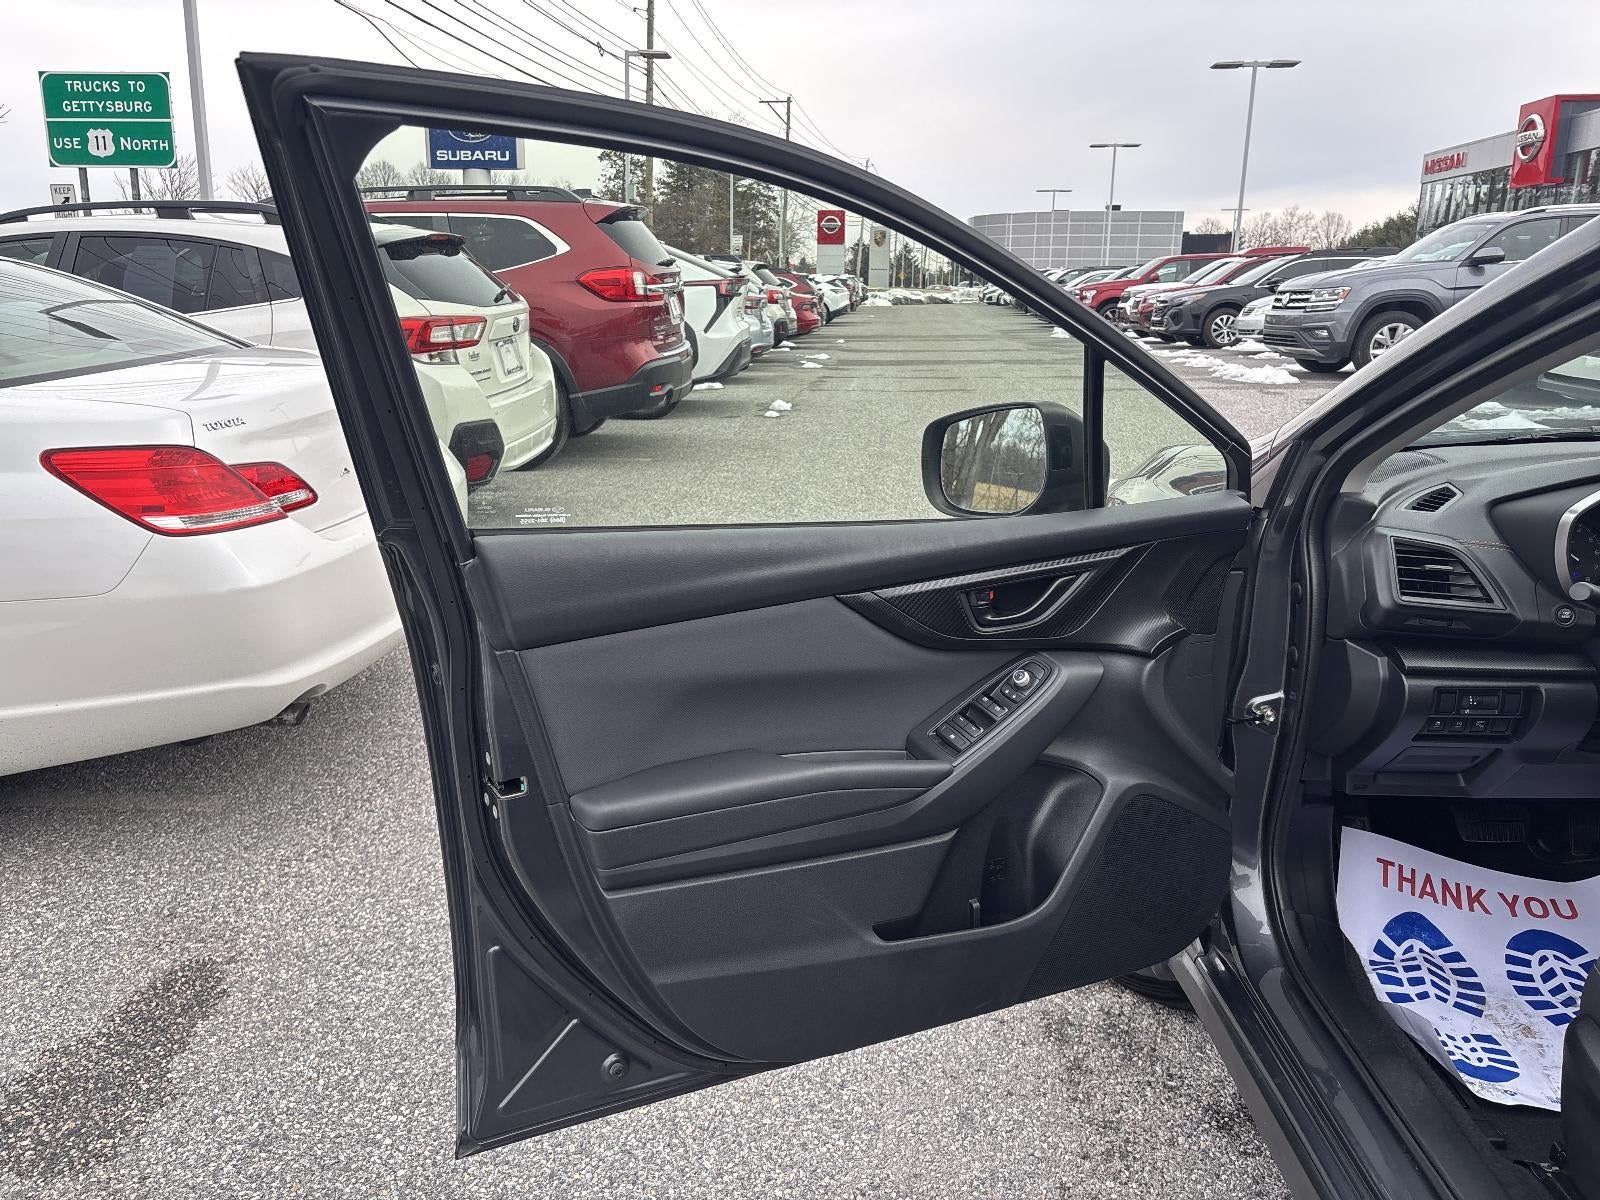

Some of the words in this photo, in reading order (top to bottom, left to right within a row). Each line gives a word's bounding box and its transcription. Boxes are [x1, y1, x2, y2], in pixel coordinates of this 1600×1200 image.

[64, 80, 121, 93] TRUCKS
[128, 80, 146, 93] TO
[62, 100, 153, 113] GETTYSBURG
[53, 137, 82, 149] USE
[94, 135, 107, 151] 11
[436, 149, 510, 161] SUBARU
[1424, 152, 1466, 175] NISSAN
[53, 186, 72, 195] KEEP
[202, 416, 247, 432] TOYOTA
[1376, 857, 1493, 916] THANK
[1497, 891, 1579, 920] YOU
